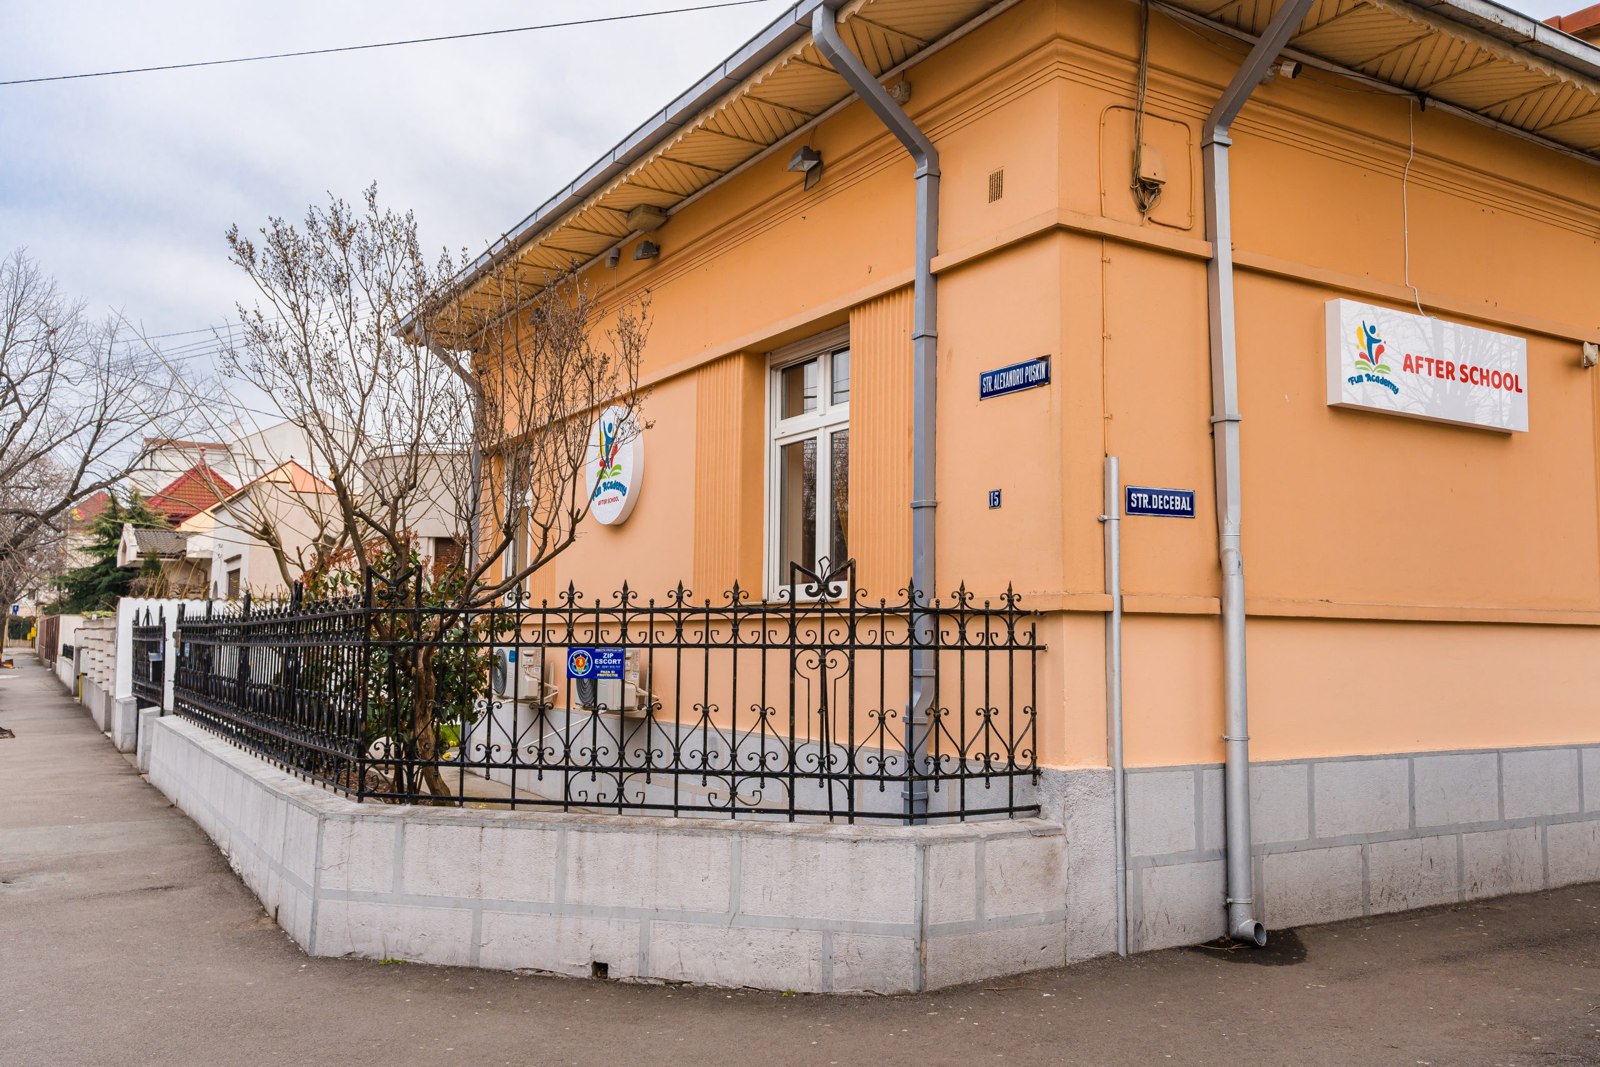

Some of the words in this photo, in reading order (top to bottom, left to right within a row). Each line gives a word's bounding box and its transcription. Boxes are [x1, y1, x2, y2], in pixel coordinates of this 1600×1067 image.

[994, 368, 1023, 390] ALEXANDRU
[1347, 374, 1364, 386] Fun
[1364, 373, 1400, 395] Academy
[1402, 353, 1456, 381] AFTER
[1459, 364, 1523, 394] SCHOOL
[990, 492, 999, 506] 15
